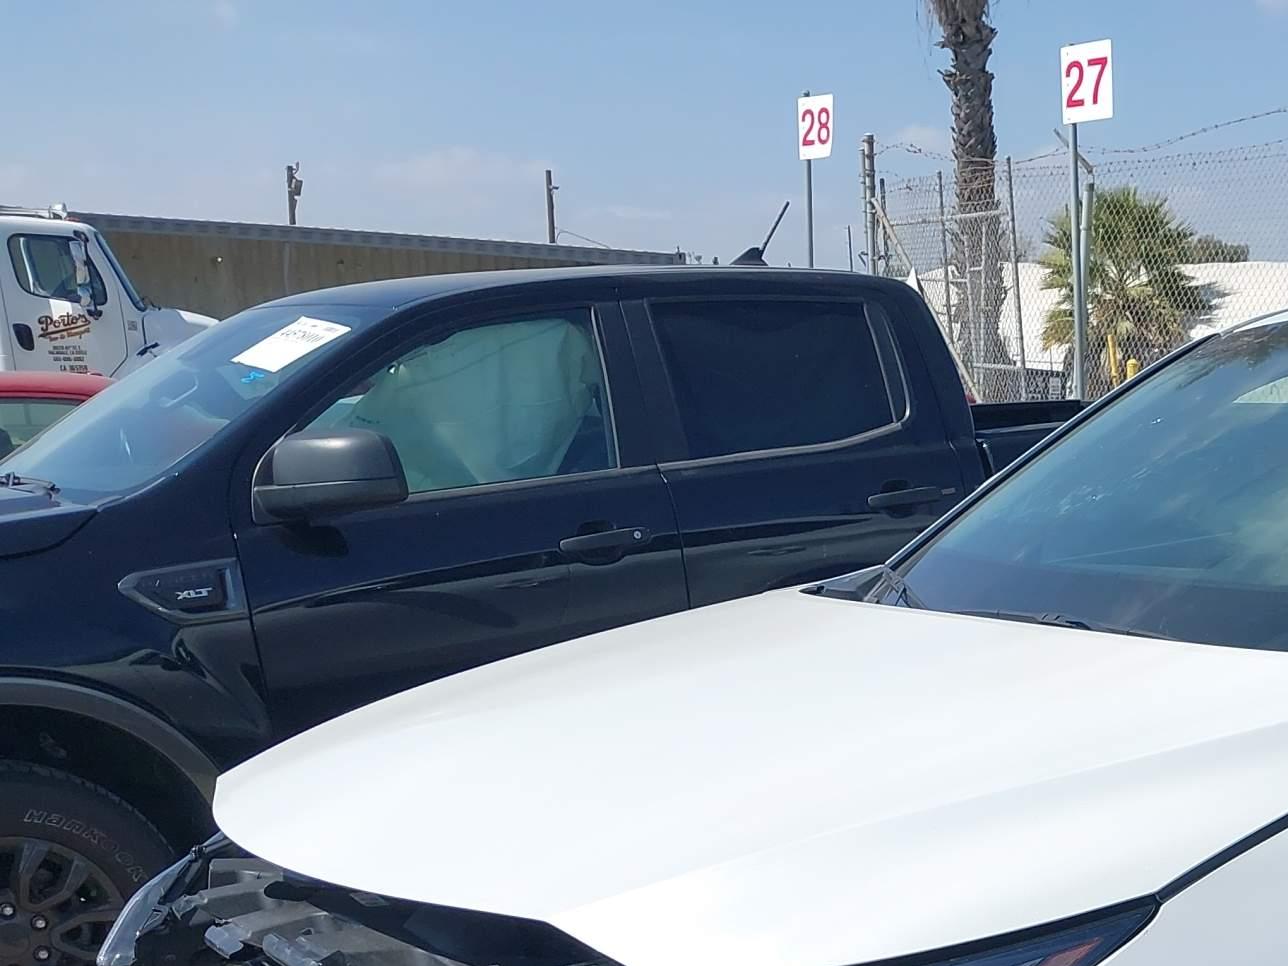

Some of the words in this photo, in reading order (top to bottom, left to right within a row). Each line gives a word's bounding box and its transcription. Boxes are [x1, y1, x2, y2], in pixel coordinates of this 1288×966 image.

[1064, 56, 1109, 108] 27
[801, 106, 831, 147] 28
[175, 587, 213, 600] XLT
